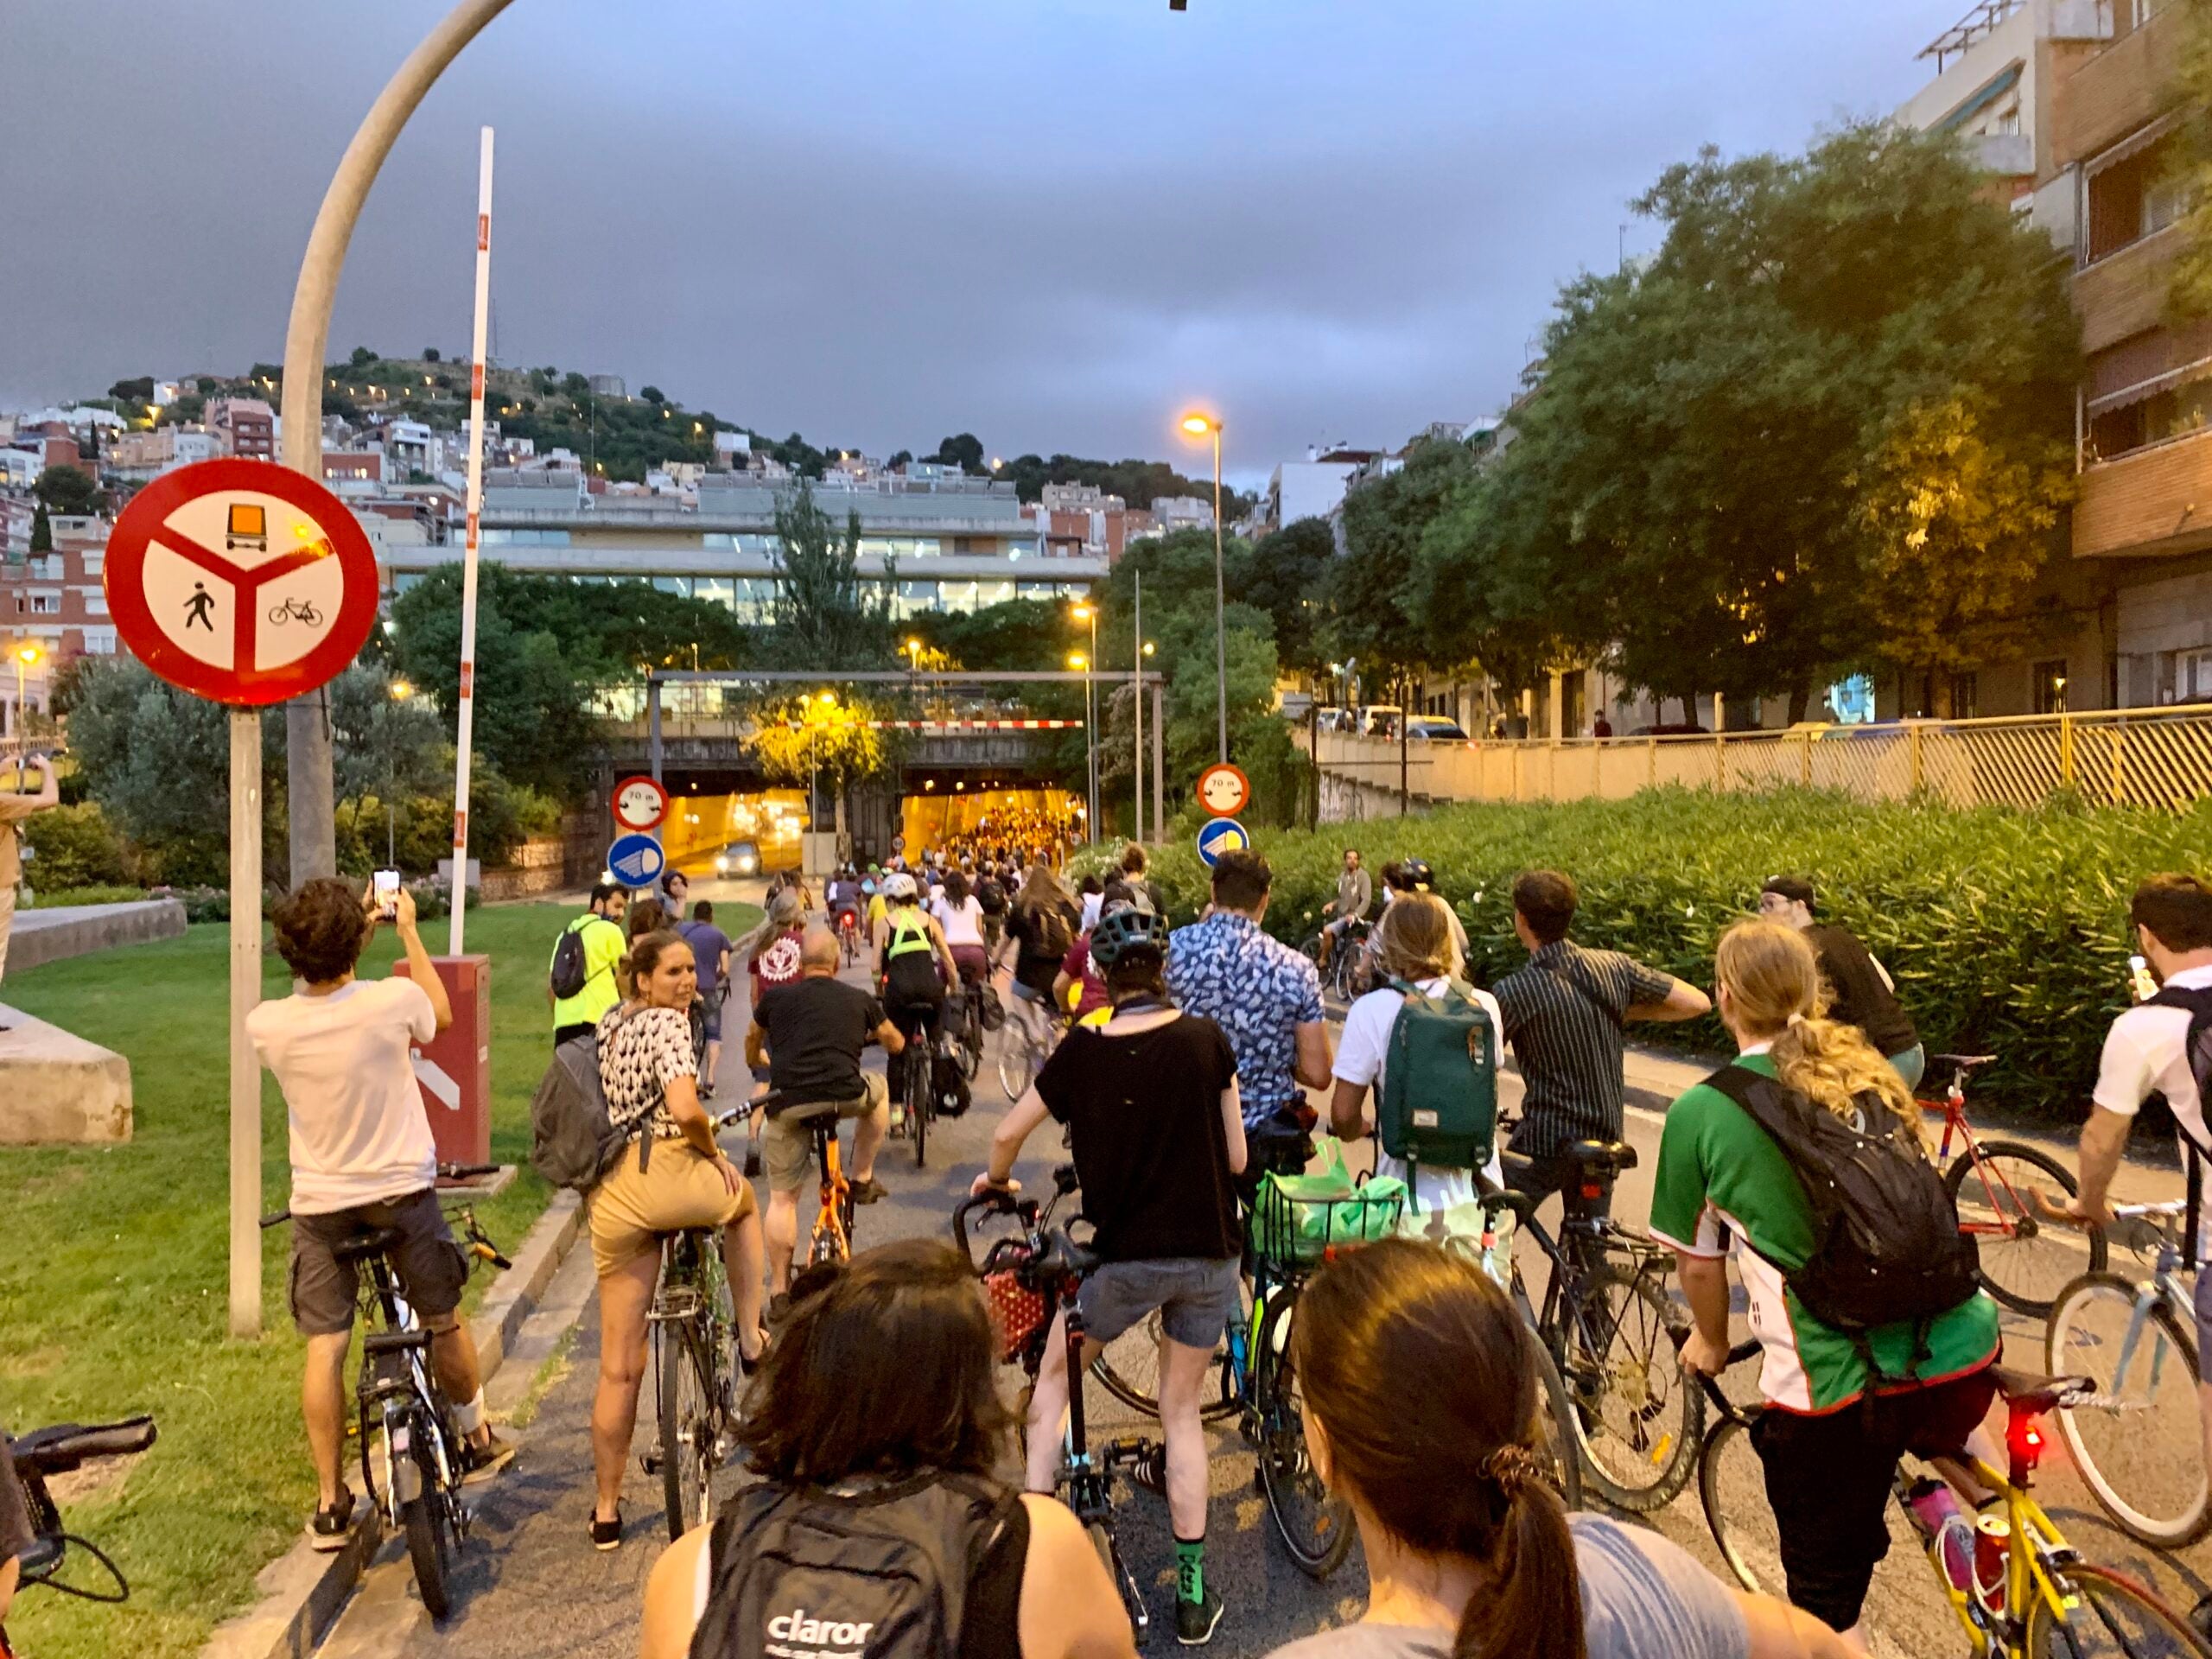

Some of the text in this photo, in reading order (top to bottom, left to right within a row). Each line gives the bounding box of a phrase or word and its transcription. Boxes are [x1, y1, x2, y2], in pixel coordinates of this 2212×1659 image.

[1211, 779, 1224, 787] 70
[629, 791, 642, 800] 70
[767, 1609, 874, 1645] claror
